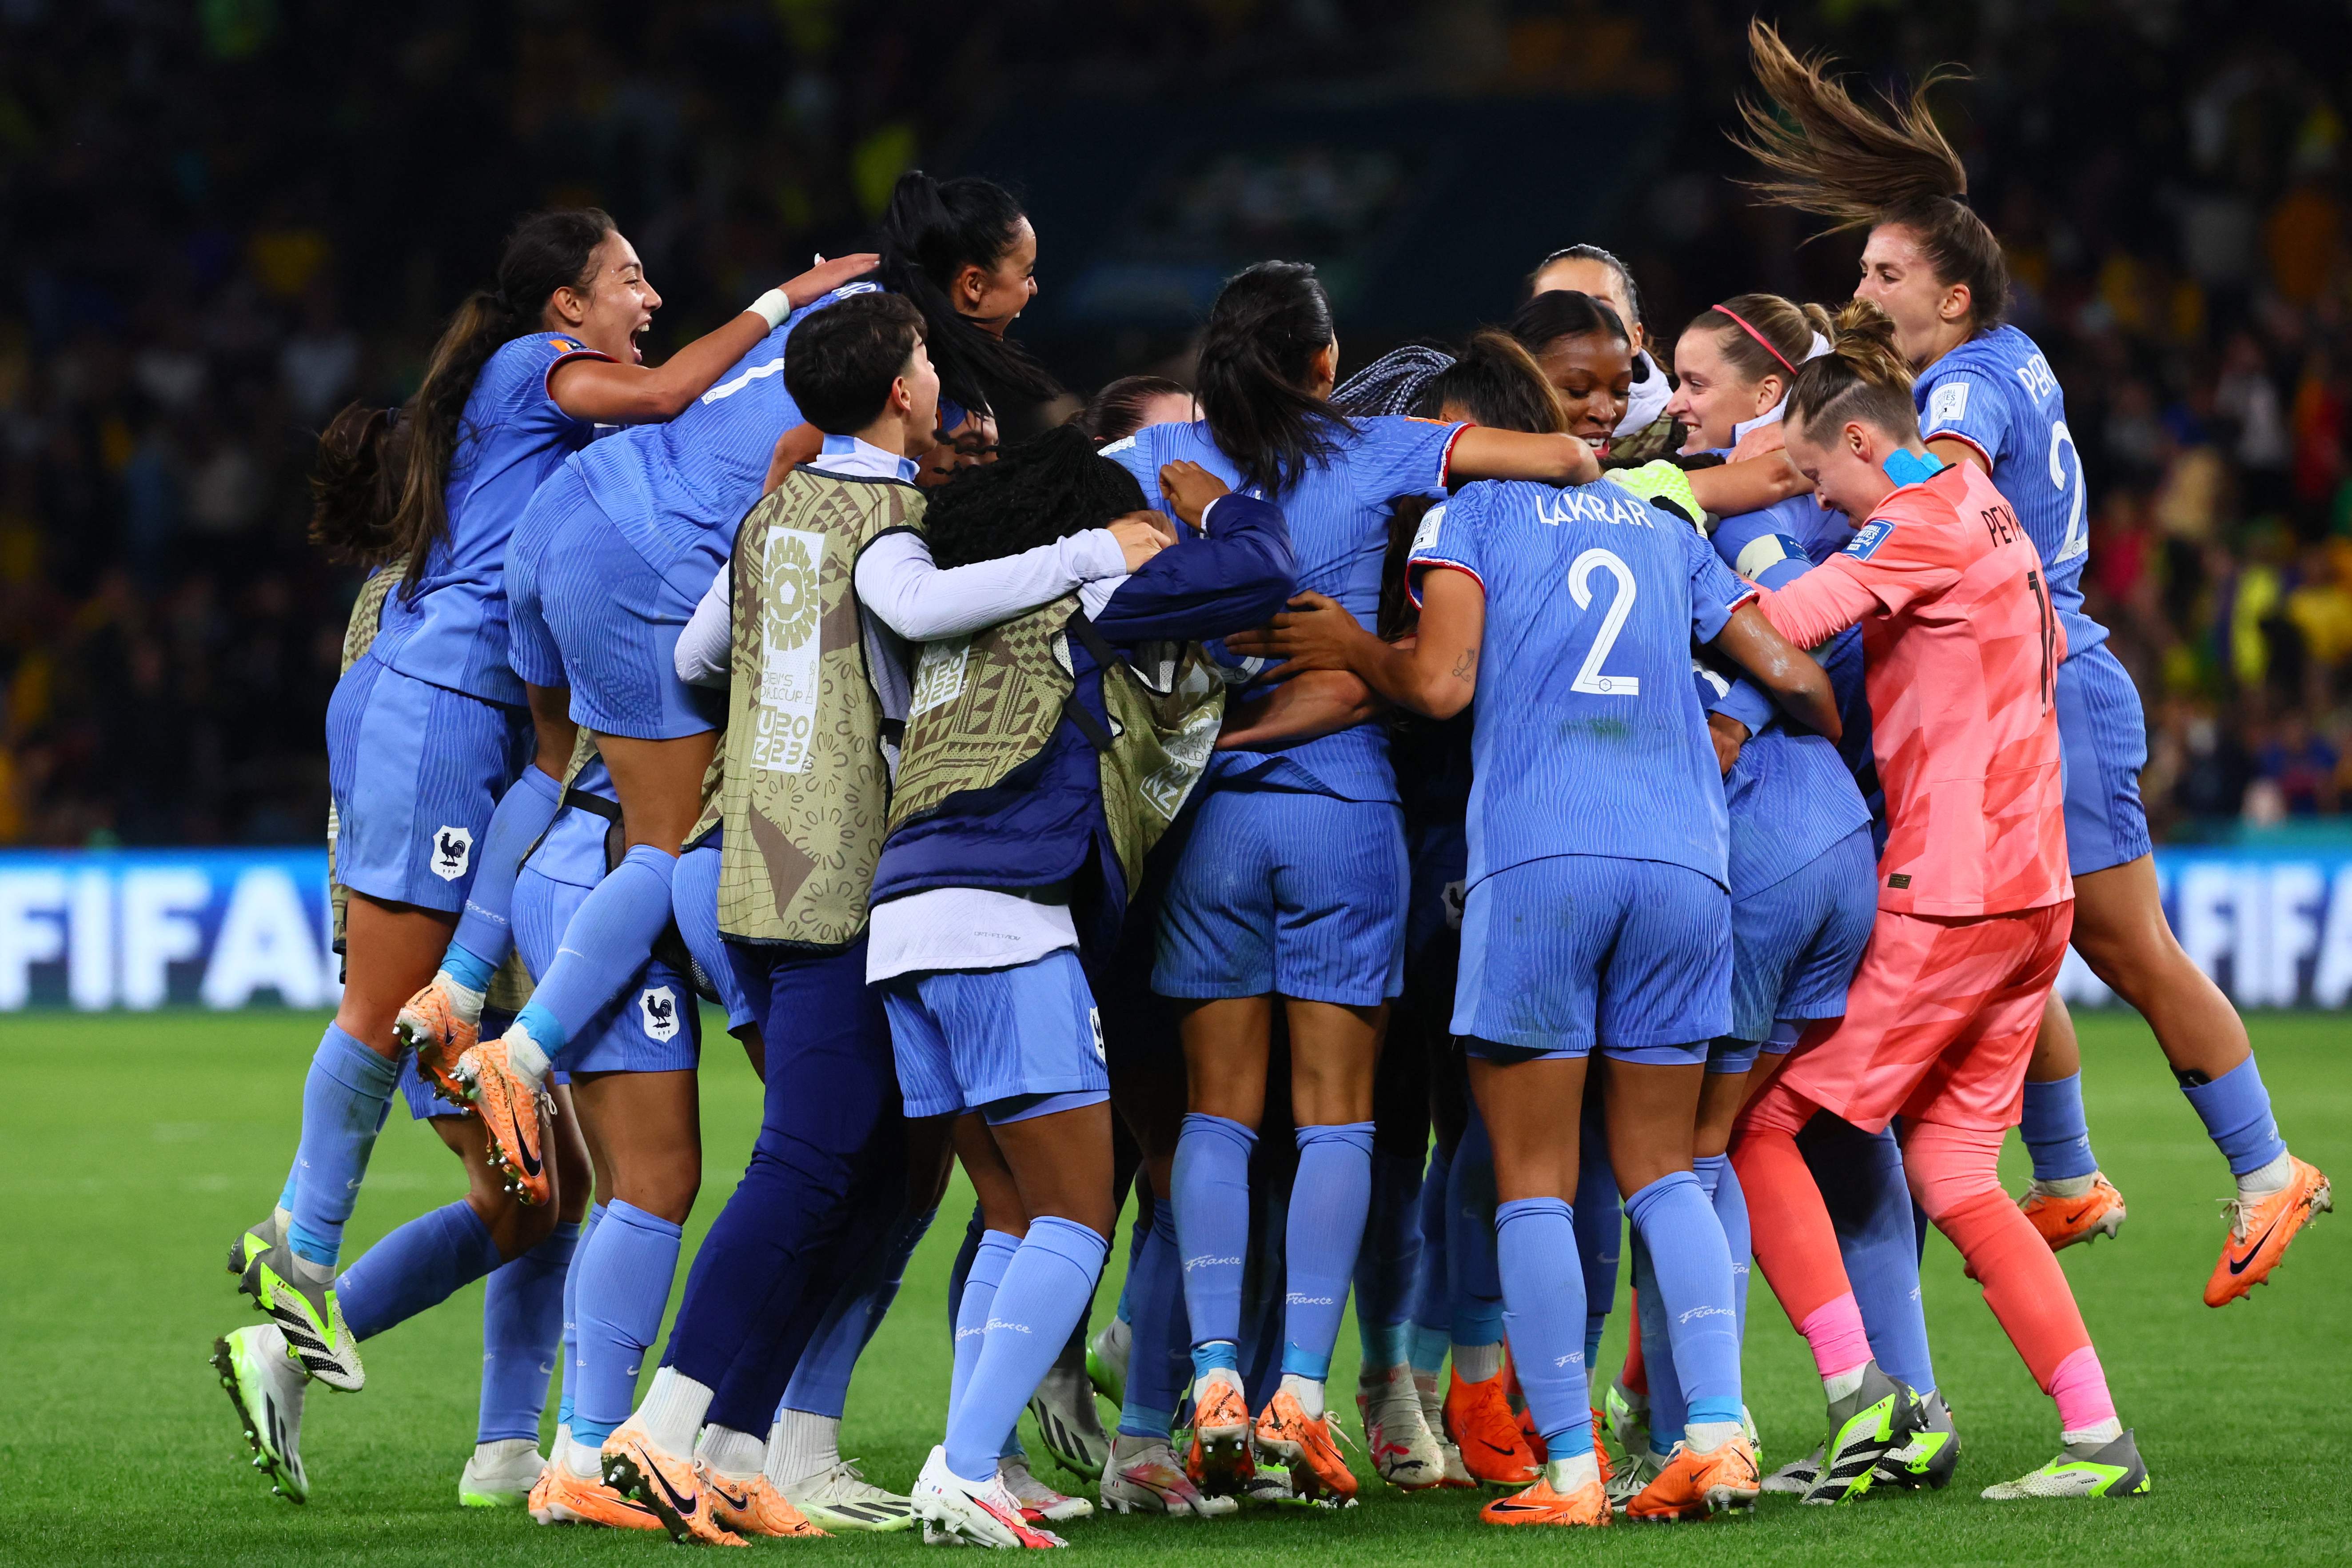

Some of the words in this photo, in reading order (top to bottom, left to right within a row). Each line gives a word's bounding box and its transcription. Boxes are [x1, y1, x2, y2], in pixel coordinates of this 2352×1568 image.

[1536, 491, 1654, 529] LAKRAR
[2049, 420, 2088, 564] 2
[1568, 548, 1638, 696] 2
[1185, 1254, 1241, 1272] France
